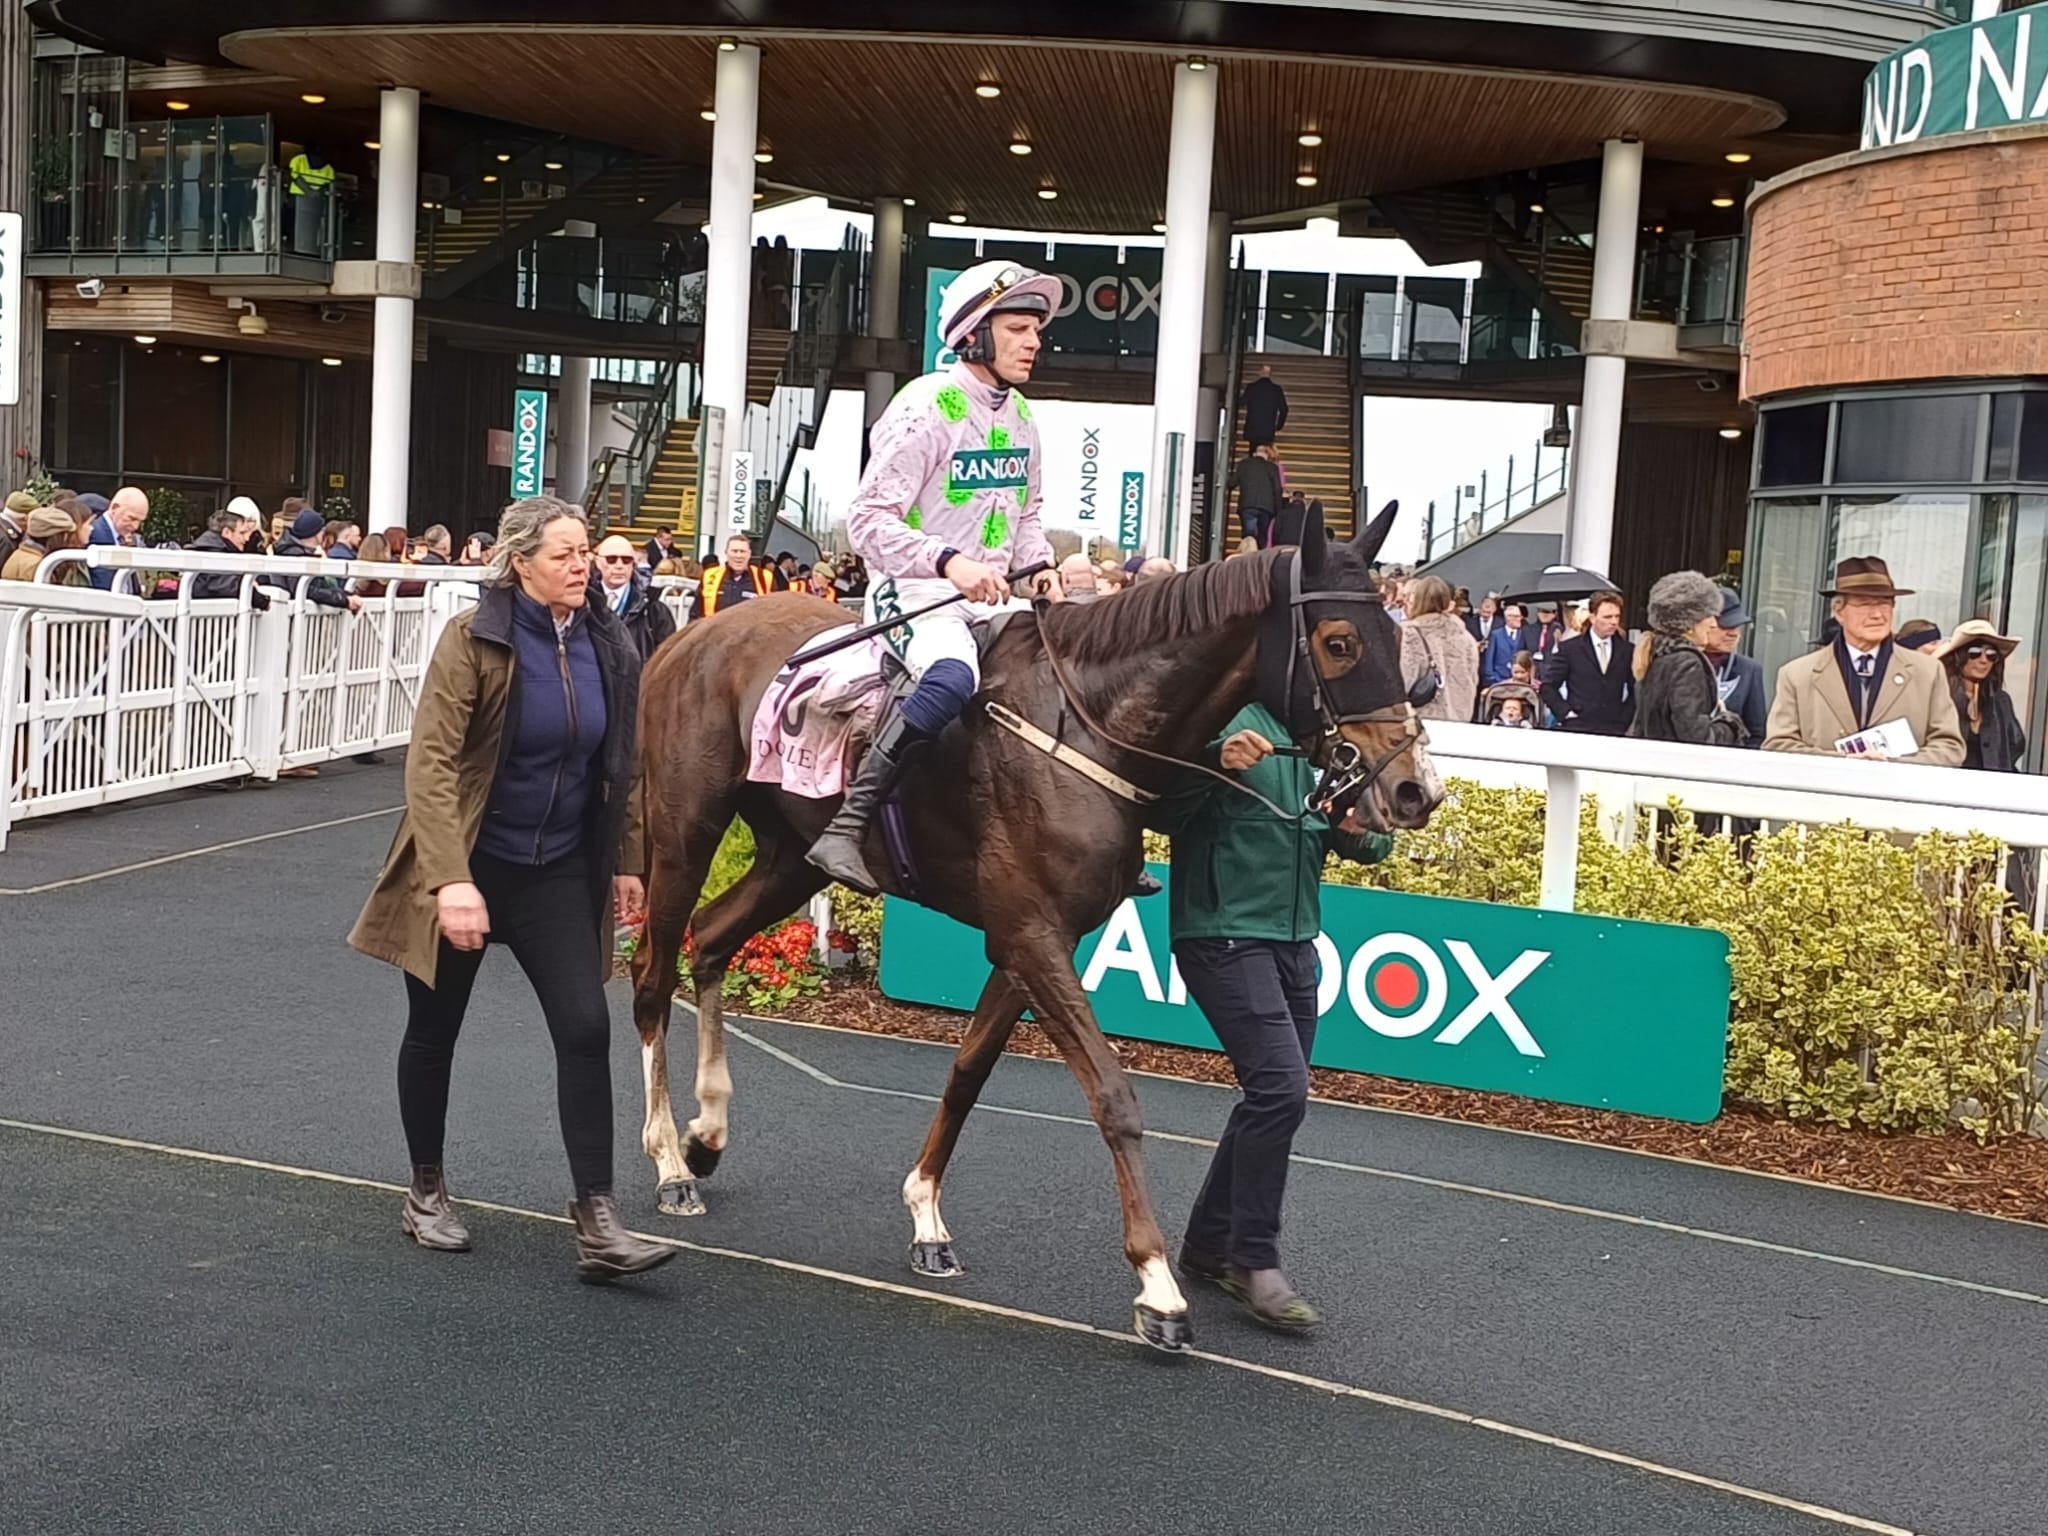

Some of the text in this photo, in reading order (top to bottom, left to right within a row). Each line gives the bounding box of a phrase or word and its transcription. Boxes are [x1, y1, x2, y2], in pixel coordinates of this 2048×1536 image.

[1964, 14, 2048, 130] N
[517, 398, 538, 492] RANDOX
[733, 458, 749, 524] RANDOX
[1079, 428, 1100, 520] RANDOX
[1123, 477, 1140, 545] RANDOX
